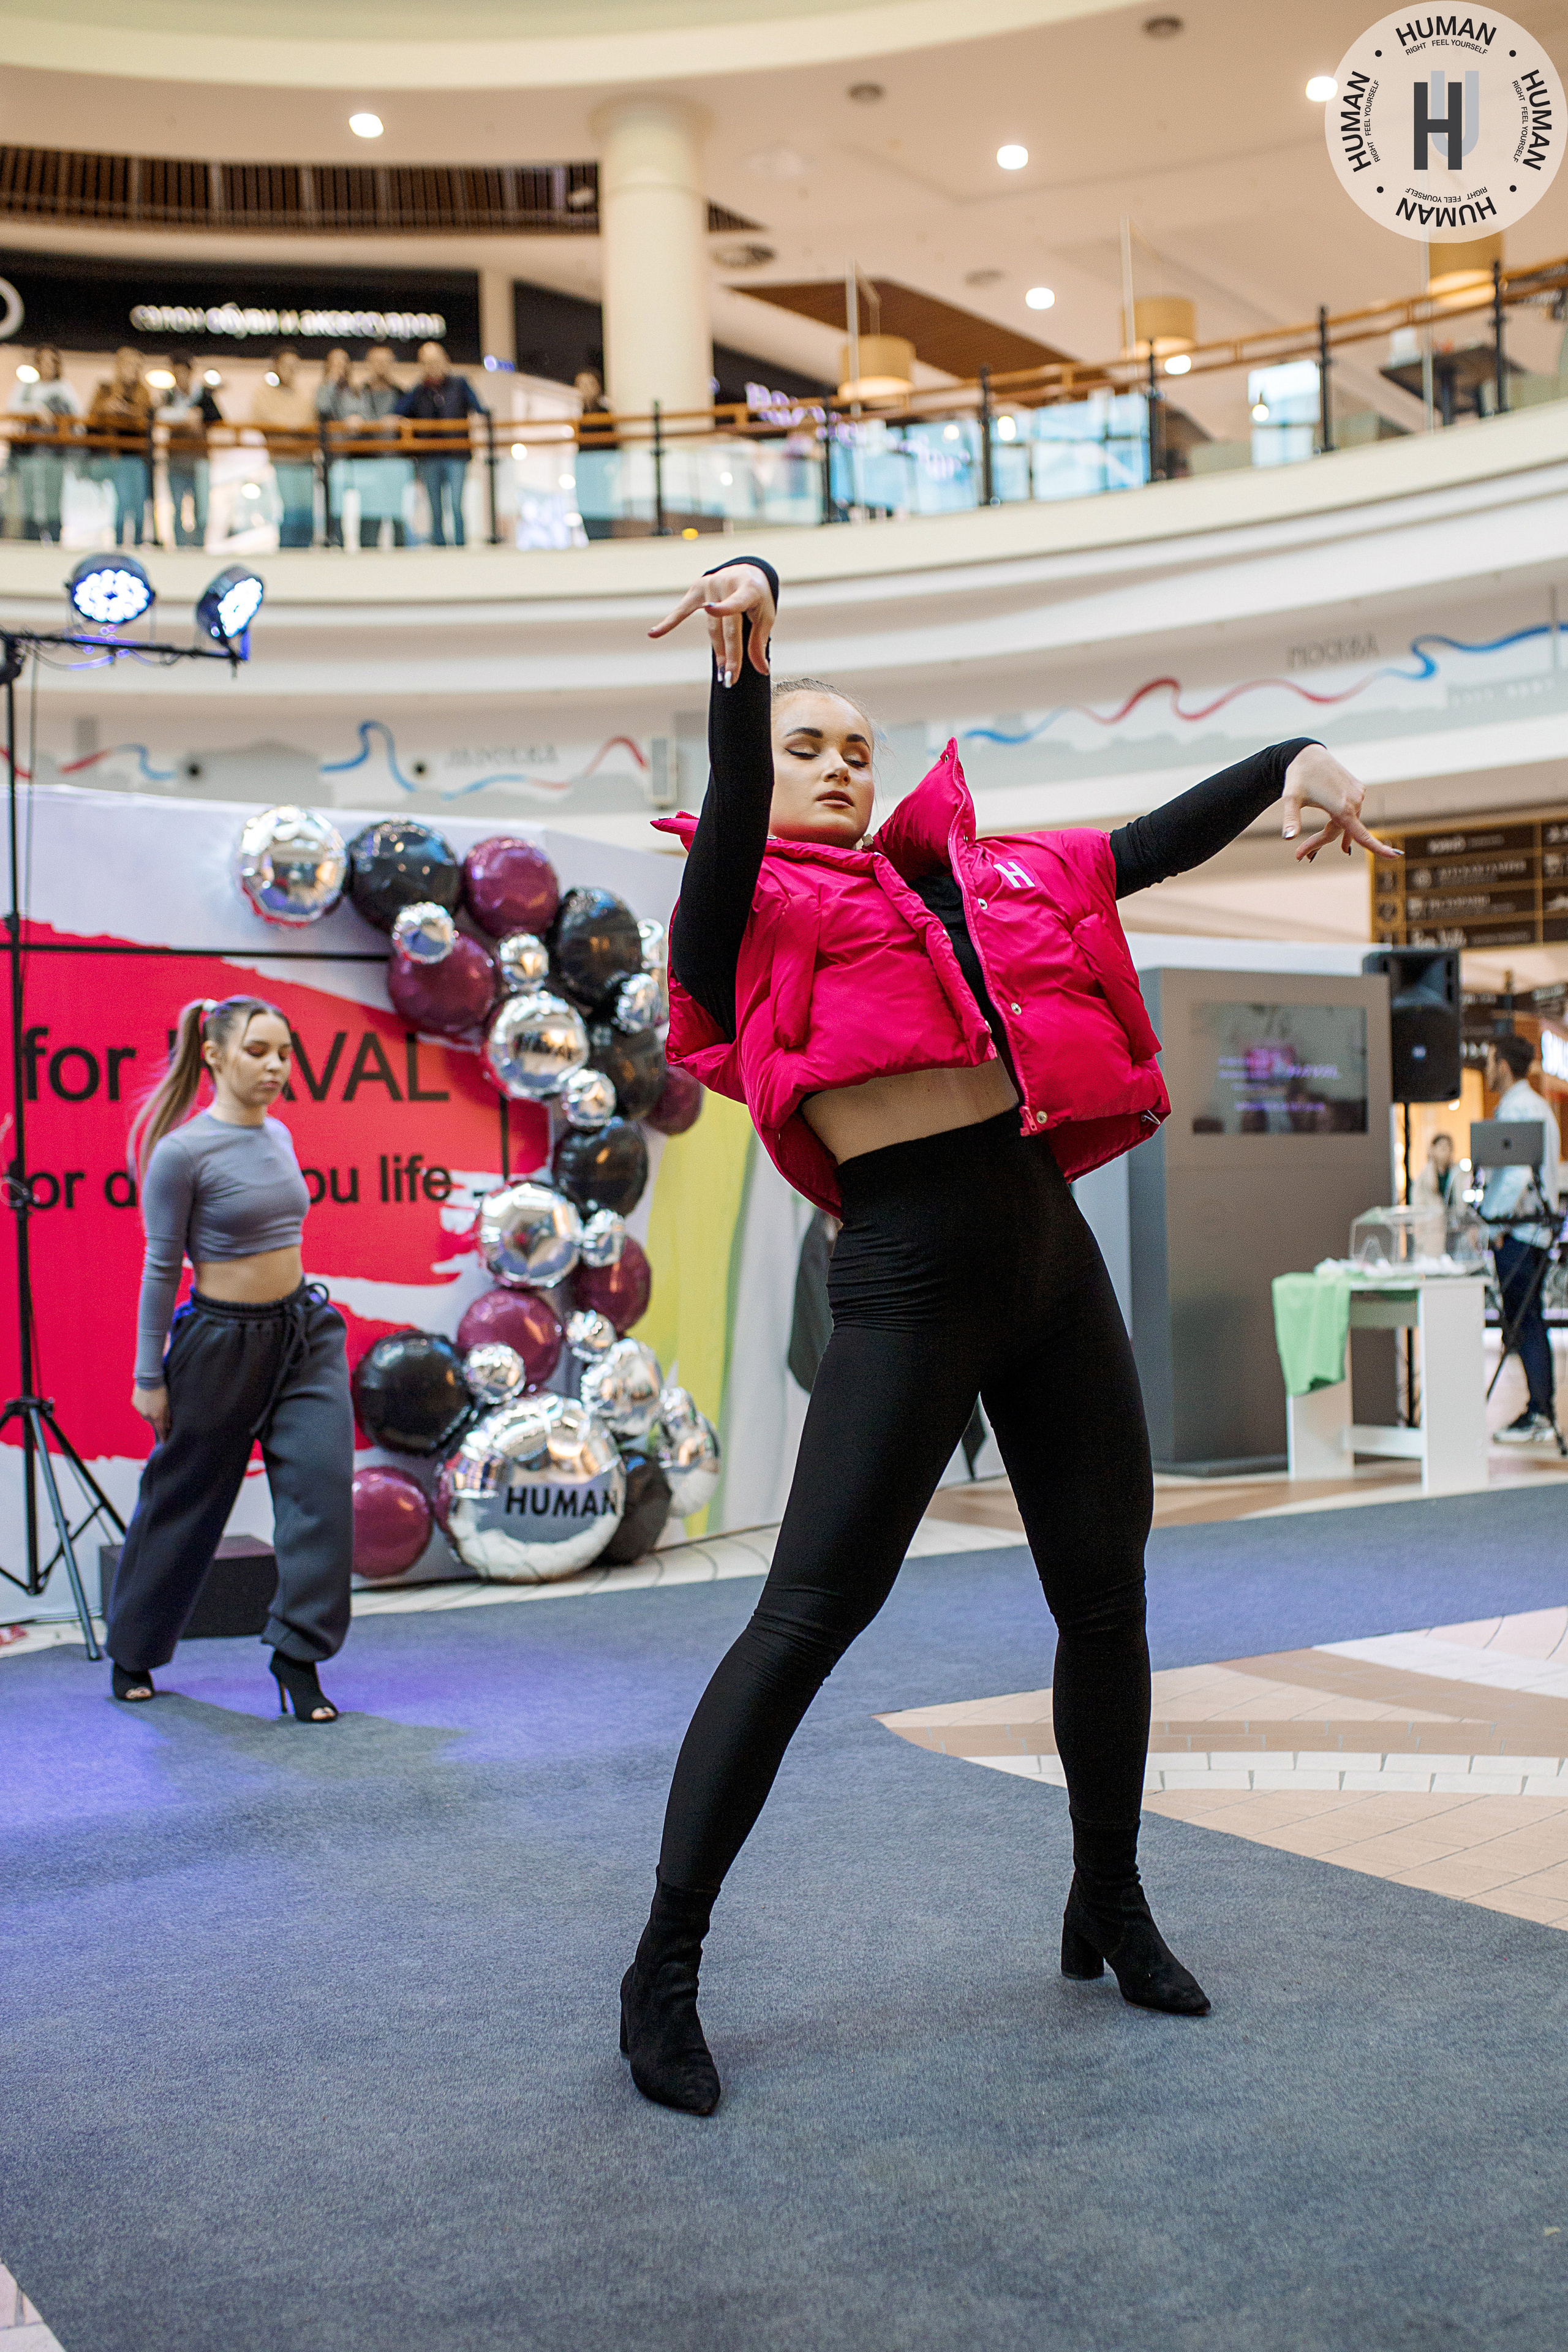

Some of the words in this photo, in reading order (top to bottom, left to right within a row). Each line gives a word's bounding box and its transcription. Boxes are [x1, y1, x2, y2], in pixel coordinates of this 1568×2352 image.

[993, 861, 1035, 888] H
[26, 1026, 137, 1101] for
[379, 1155, 451, 1202] life
[507, 1487, 616, 1516] HUMAN
